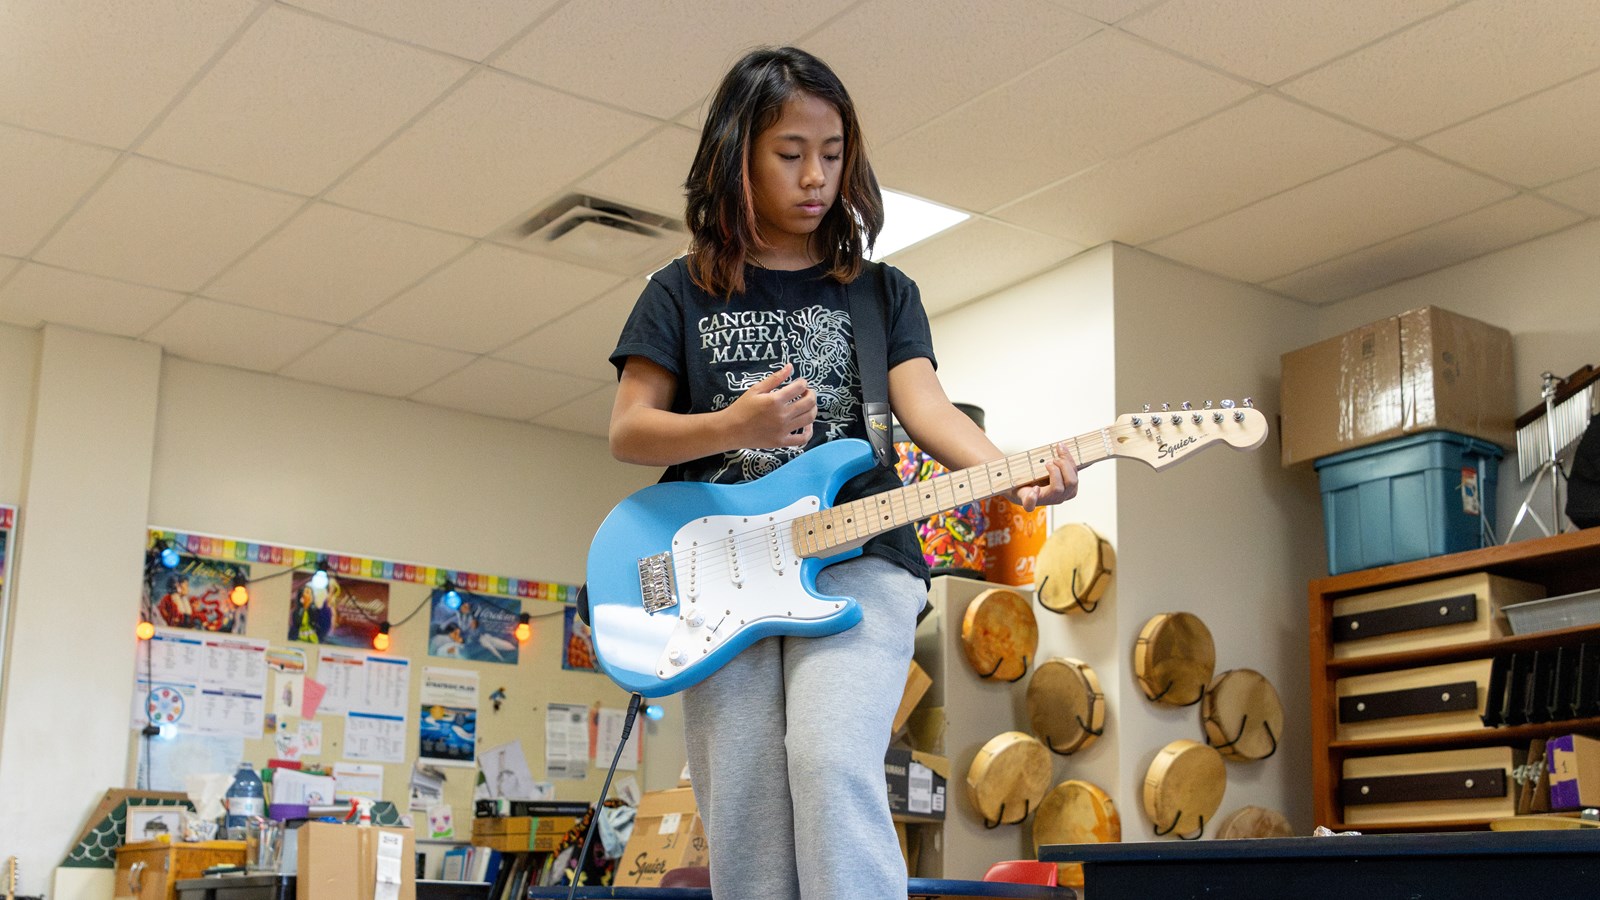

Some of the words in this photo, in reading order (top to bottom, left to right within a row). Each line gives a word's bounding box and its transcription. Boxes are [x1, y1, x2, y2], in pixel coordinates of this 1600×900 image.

[698, 310, 786, 333] CANCUN
[700, 325, 788, 349] RIVIERA
[709, 343, 778, 363] MAYA
[1158, 436, 1197, 459] Squier
[628, 851, 667, 885] Squier
